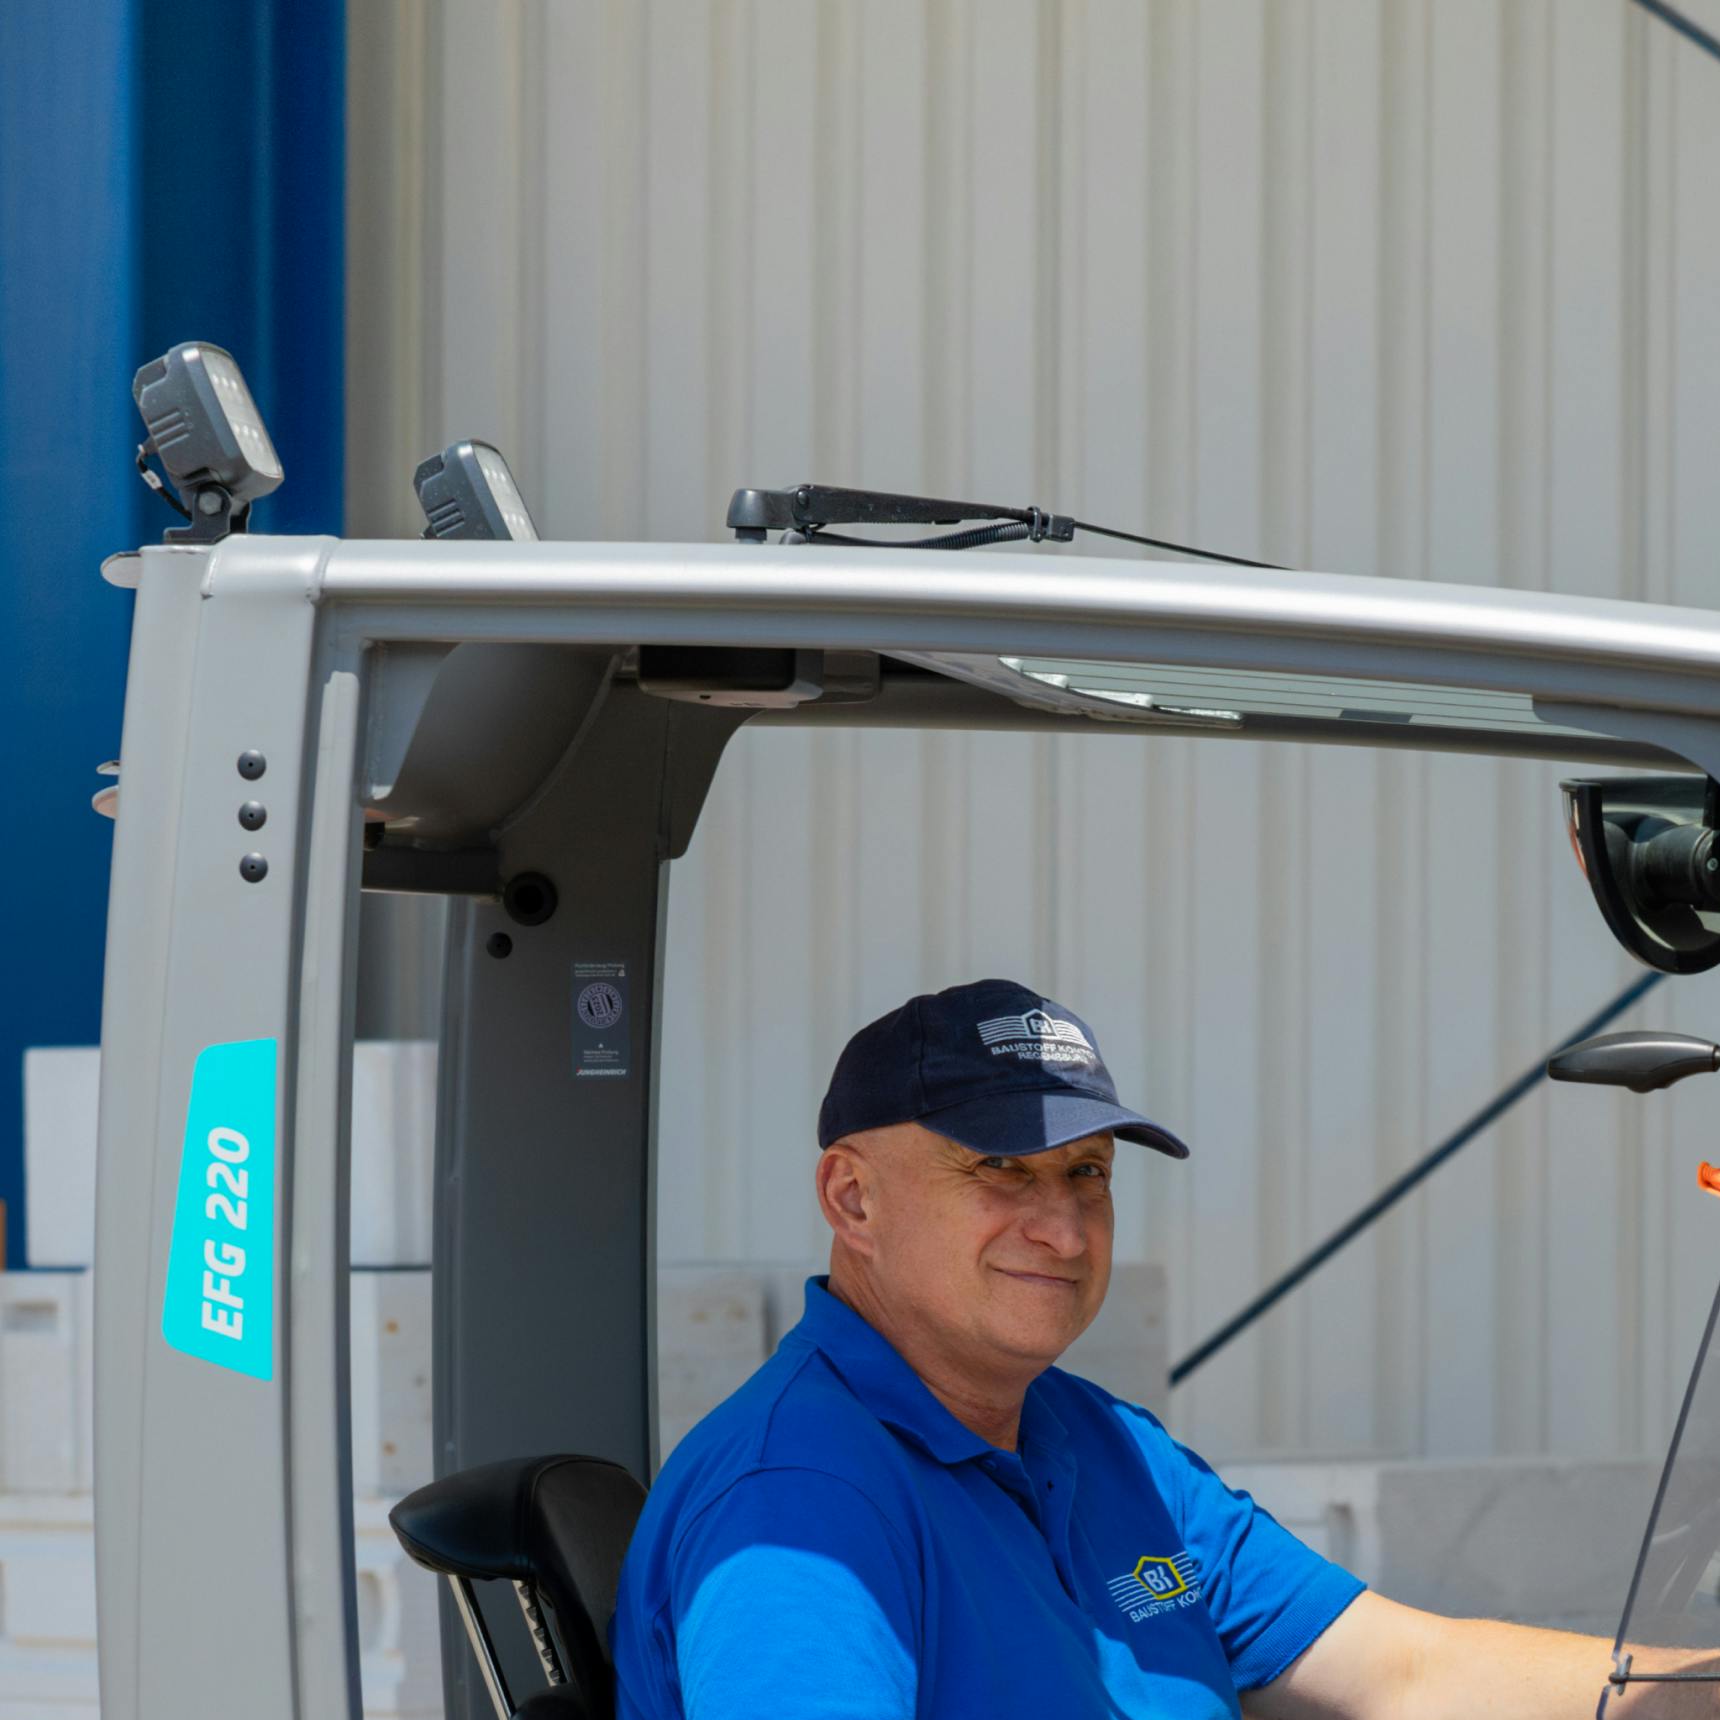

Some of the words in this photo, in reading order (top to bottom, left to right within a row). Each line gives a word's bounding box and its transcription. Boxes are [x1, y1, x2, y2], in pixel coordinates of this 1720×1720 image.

[991, 1043, 1056, 1055] BAUSTOFF
[205, 1125, 250, 1231] 220
[201, 1238, 246, 1341] EFG
